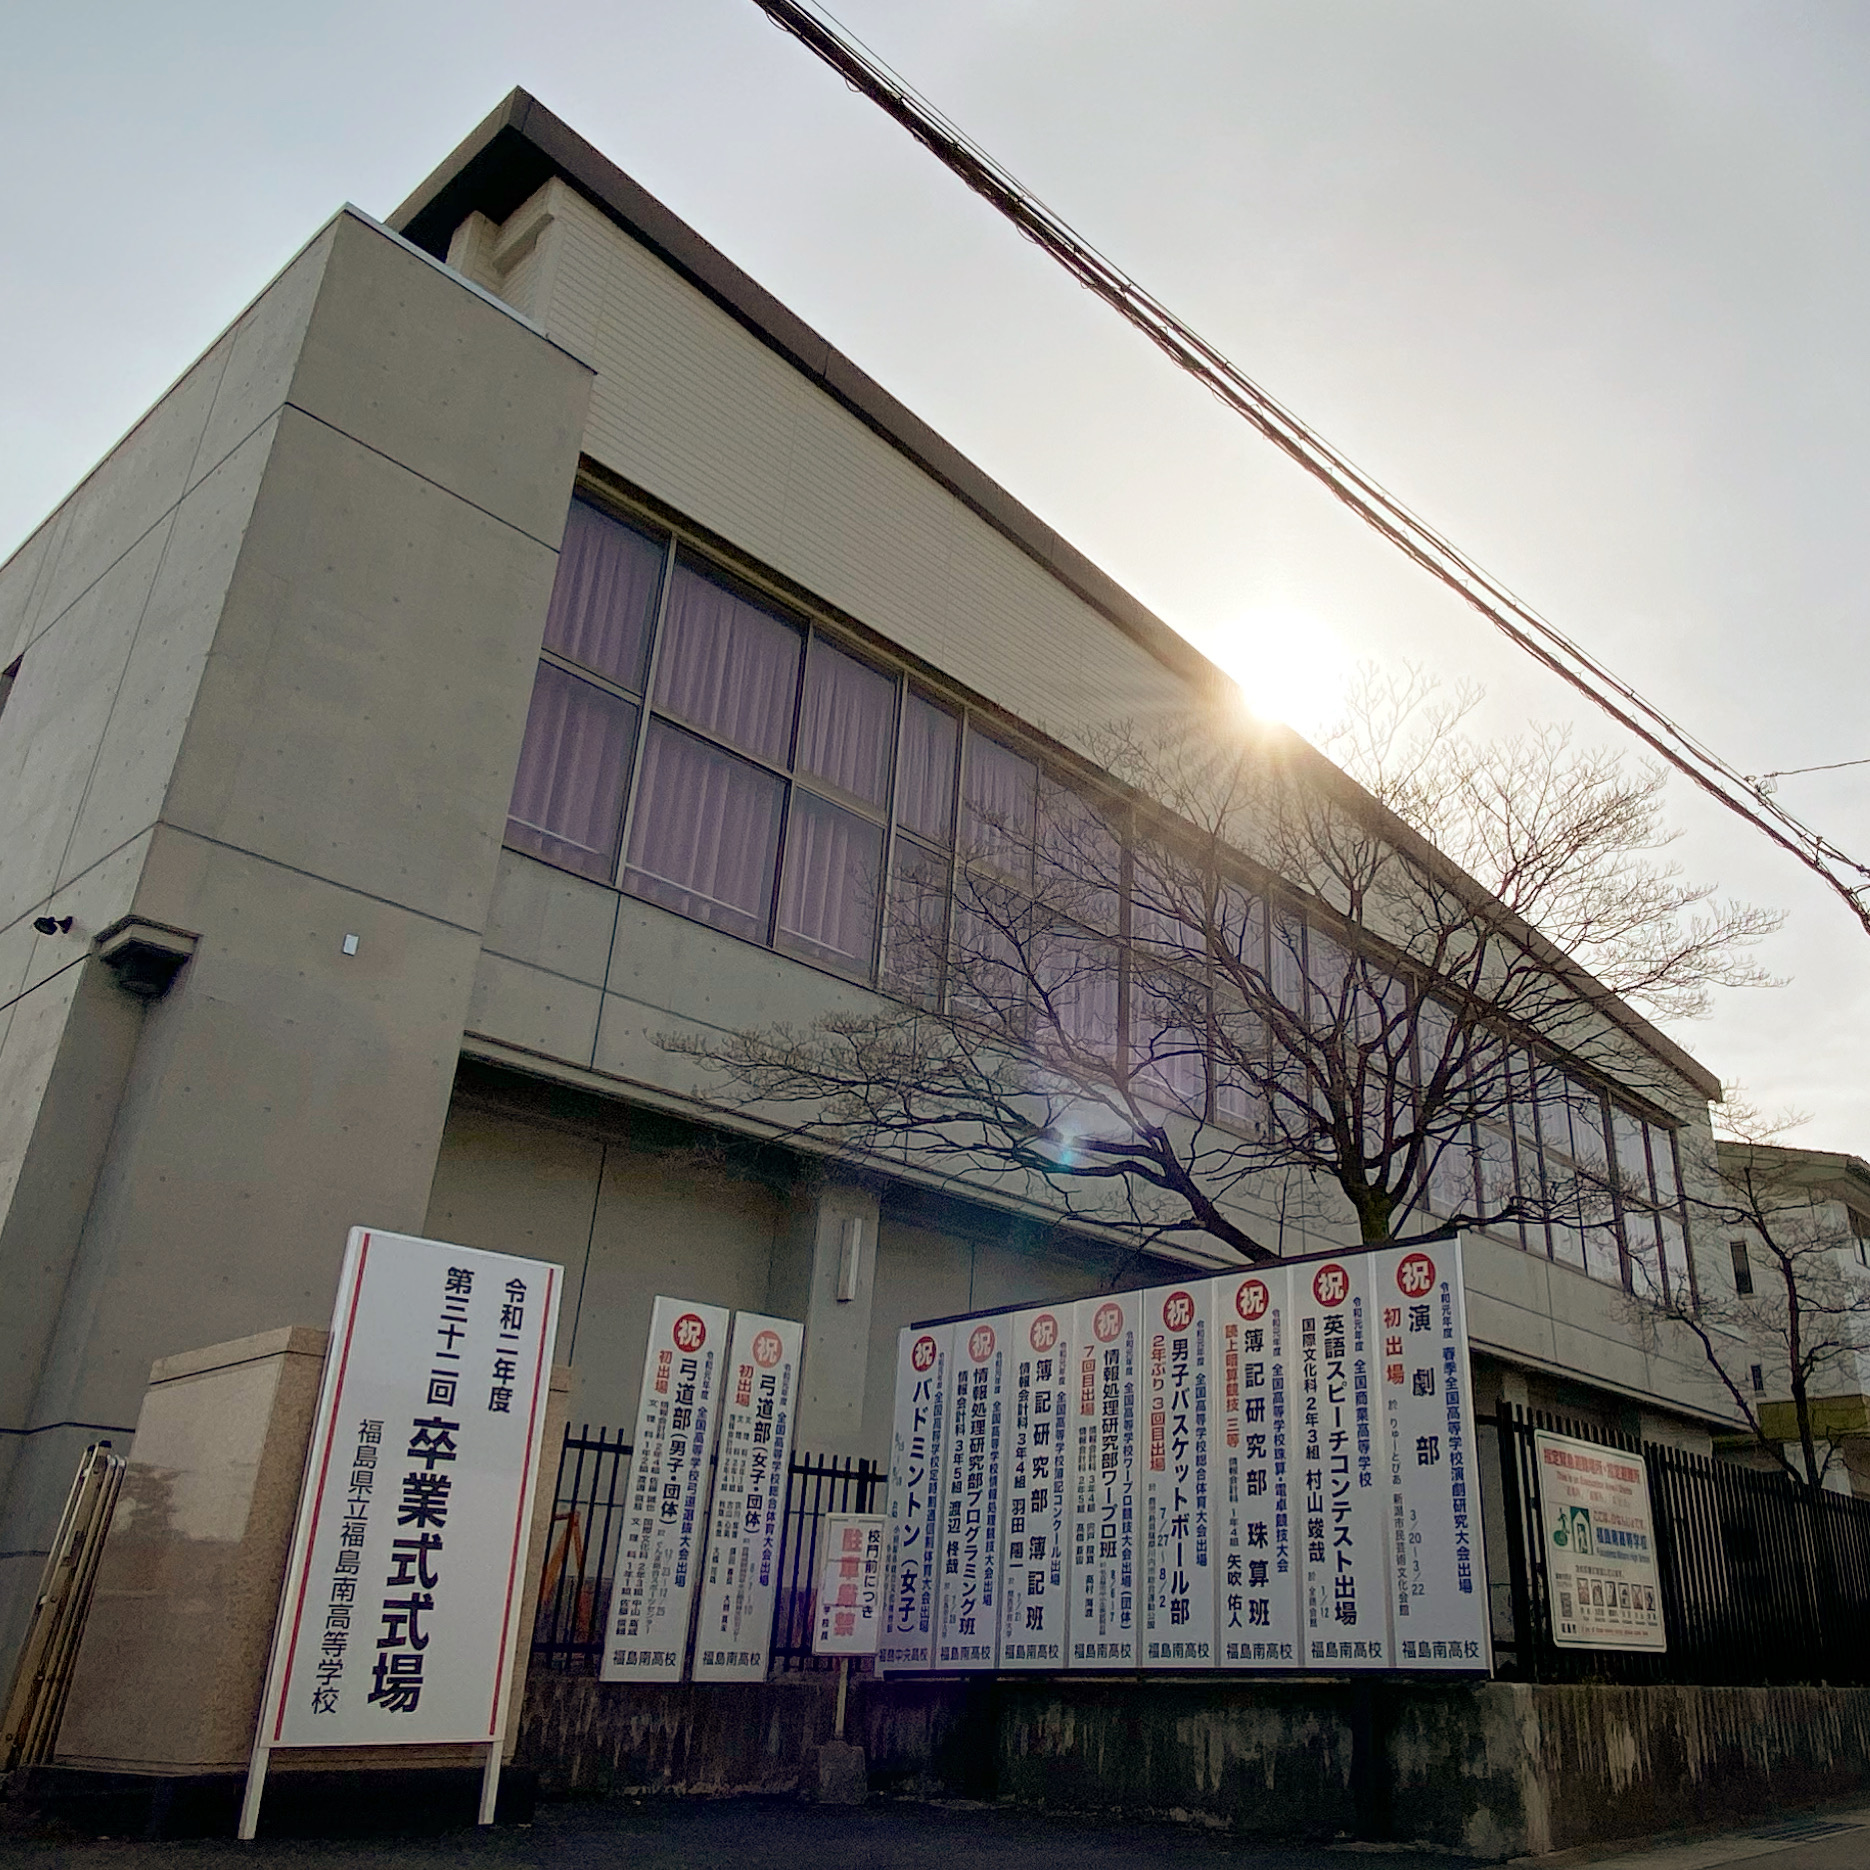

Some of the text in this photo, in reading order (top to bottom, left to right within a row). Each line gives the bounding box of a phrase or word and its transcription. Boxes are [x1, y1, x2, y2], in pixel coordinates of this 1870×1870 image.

[1238, 1283, 1266, 1318] 祝
[1316, 1268, 1346, 1305] 祝
[1399, 1257, 1432, 1295] 祝
[676, 1317, 704, 1350] 祝
[1032, 1318, 1055, 1350] 祝
[1095, 1306, 1120, 1340] 祝
[1165, 1295, 1192, 1330] 祝
[488, 1278, 527, 1413] 令和二年度
[656, 1350, 673, 1394] 初出場
[755, 1334, 780, 1365] 祝
[913, 1338, 935, 1370] 祝
[971, 1329, 993, 1360] 祝
[1302, 1318, 1317, 1393] 国際文化科
[1384, 1307, 1405, 1386] 初出場
[735, 1364, 754, 1407] 初出場
[956, 1370, 968, 1436] 情報会計科
[1017, 1362, 1030, 1430] 情報会計科
[1080, 1345, 1096, 1416] 7回目出場
[1150, 1335, 1166, 1471] 2年ぶり 3回目出場
[1352, 1296, 1372, 1487] 令和元年度 全国商業高等学校
[1408, 1304, 1440, 1465] 演劇部
[658, 1358, 698, 1525] 弓道部（男子・団体）
[743, 1374, 777, 1534] 弓道部（女子・団体）
[1099, 1349, 1120, 1558] 情報処理研究部ワープロ班
[1305, 1397, 1320, 1461] 2年3組
[1389, 1418, 1402, 1485] りゅーとぴあ
[1440, 1281, 1473, 1593] 令和元年度 春季全国高等学校演劇研究大会出場
[951, 1439, 964, 1493] 3年5組
[1014, 1433, 1027, 1489] 3年4組
[1171, 1339, 1190, 1625] 男子バスケットボール部
[1195, 1373, 1208, 1566] 全国高等学校総合体育大会出場
[1245, 1328, 1270, 1626] 簿記研究部 珠算班
[1272, 1363, 1289, 1573] 全国高等学校珠算・電卓競技大会
[1323, 1314, 1357, 1626] 英語スピーチコンテスト出場
[367, 1266, 475, 1714] 第三十二回 卒業式式場
[897, 1378, 933, 1633] バドミントン（女子）
[959, 1368, 989, 1635] 情報処理研究部プログラミング班
[1011, 1498, 1026, 1534] 羽田
[1026, 1359, 1053, 1631] 簿記研究部 簿記班
[1306, 1468, 1323, 1513] 村山
[311, 1419, 384, 1715] 福島県立福島南高等学校
[862, 1530, 880, 1618] 校門前につき
[1227, 1553, 1242, 1586] 矢吹
[1227, 1594, 1243, 1628] 佑人
[613, 1650, 677, 1666] 福島南高校
[703, 1651, 761, 1666] 福島南高校
[940, 1646, 991, 1661] 福島南高校
[1005, 1644, 1059, 1659] 福島南高校
[1074, 1643, 1131, 1659] 福島南高校
[1148, 1643, 1210, 1659] 福島南高校
[1226, 1643, 1293, 1660] 福島南高校
[1312, 1641, 1382, 1659] 福島南高校
[1402, 1640, 1479, 1659] 福島南高校
